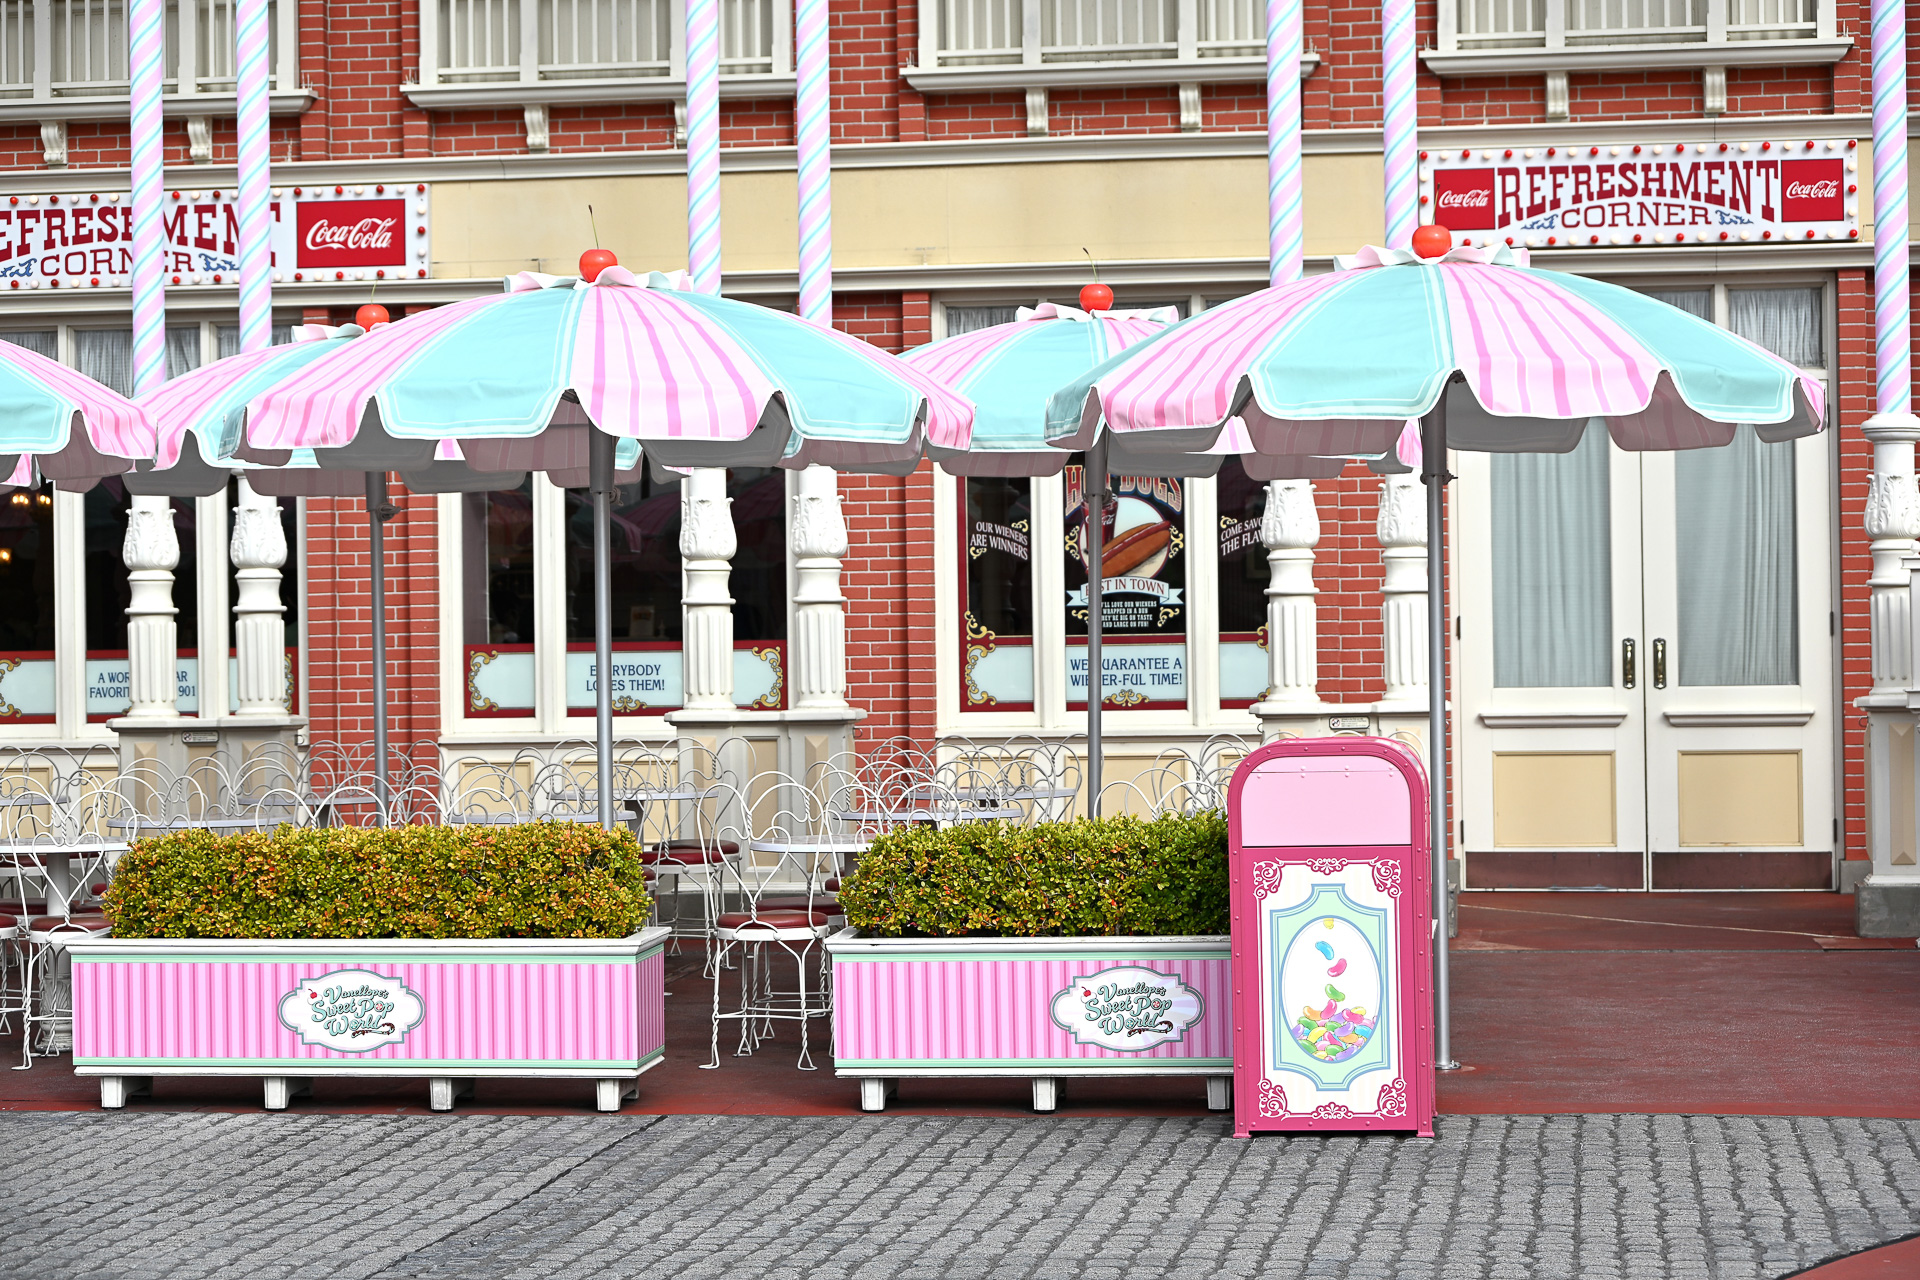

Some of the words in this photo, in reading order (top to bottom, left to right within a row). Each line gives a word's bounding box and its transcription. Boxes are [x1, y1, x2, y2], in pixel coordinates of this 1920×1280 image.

[1438, 189, 1491, 208] Coca-Cola
[1497, 160, 1779, 230] REFRESHMENT
[1785, 179, 1840, 199] Coca-Cola
[1561, 202, 1712, 228] CORNER
[0, 202, 281, 268] EFRESMEN
[305, 217, 397, 250] Coca-Cola
[40, 247, 195, 277] CORR
[975, 521, 994, 533] OUR
[994, 523, 1028, 546] WIENERS
[1220, 522, 1243, 542] COME
[1244, 516, 1263, 531] SAVO
[969, 533, 988, 547] ARE
[988, 535, 1028, 561] WINNERS
[1220, 536, 1240, 556] THE
[1115, 578, 1127, 590] IN
[1129, 578, 1165, 595] TOWN
[1134, 600, 1157, 608] WIENERS
[1136, 613, 1153, 621] TASTE
[590, 664, 662, 676] ERYBODY
[1070, 659, 1089, 671] WE
[1101, 658, 1170, 670] UARANTEE
[1173, 657, 1183, 669] A
[97, 672, 106, 684] A
[586, 680, 626, 691] LES
[628, 679, 665, 691] THEM!
[1070, 673, 1146, 687] WIEER-FUL
[1149, 673, 1183, 685] TIME!
[89, 686, 130, 698] FAVORIT
[178, 685, 196, 697] 901
[323, 984, 390, 1005] Vanellope's
[1097, 981, 1167, 1004] Vanellope's
[311, 998, 358, 1023] Sweet
[353, 998, 395, 1019] Pop
[1084, 995, 1134, 1022] Sweet
[1129, 995, 1173, 1017] Pop
[323, 1014, 382, 1037] World
[1097, 1011, 1160, 1036] World
